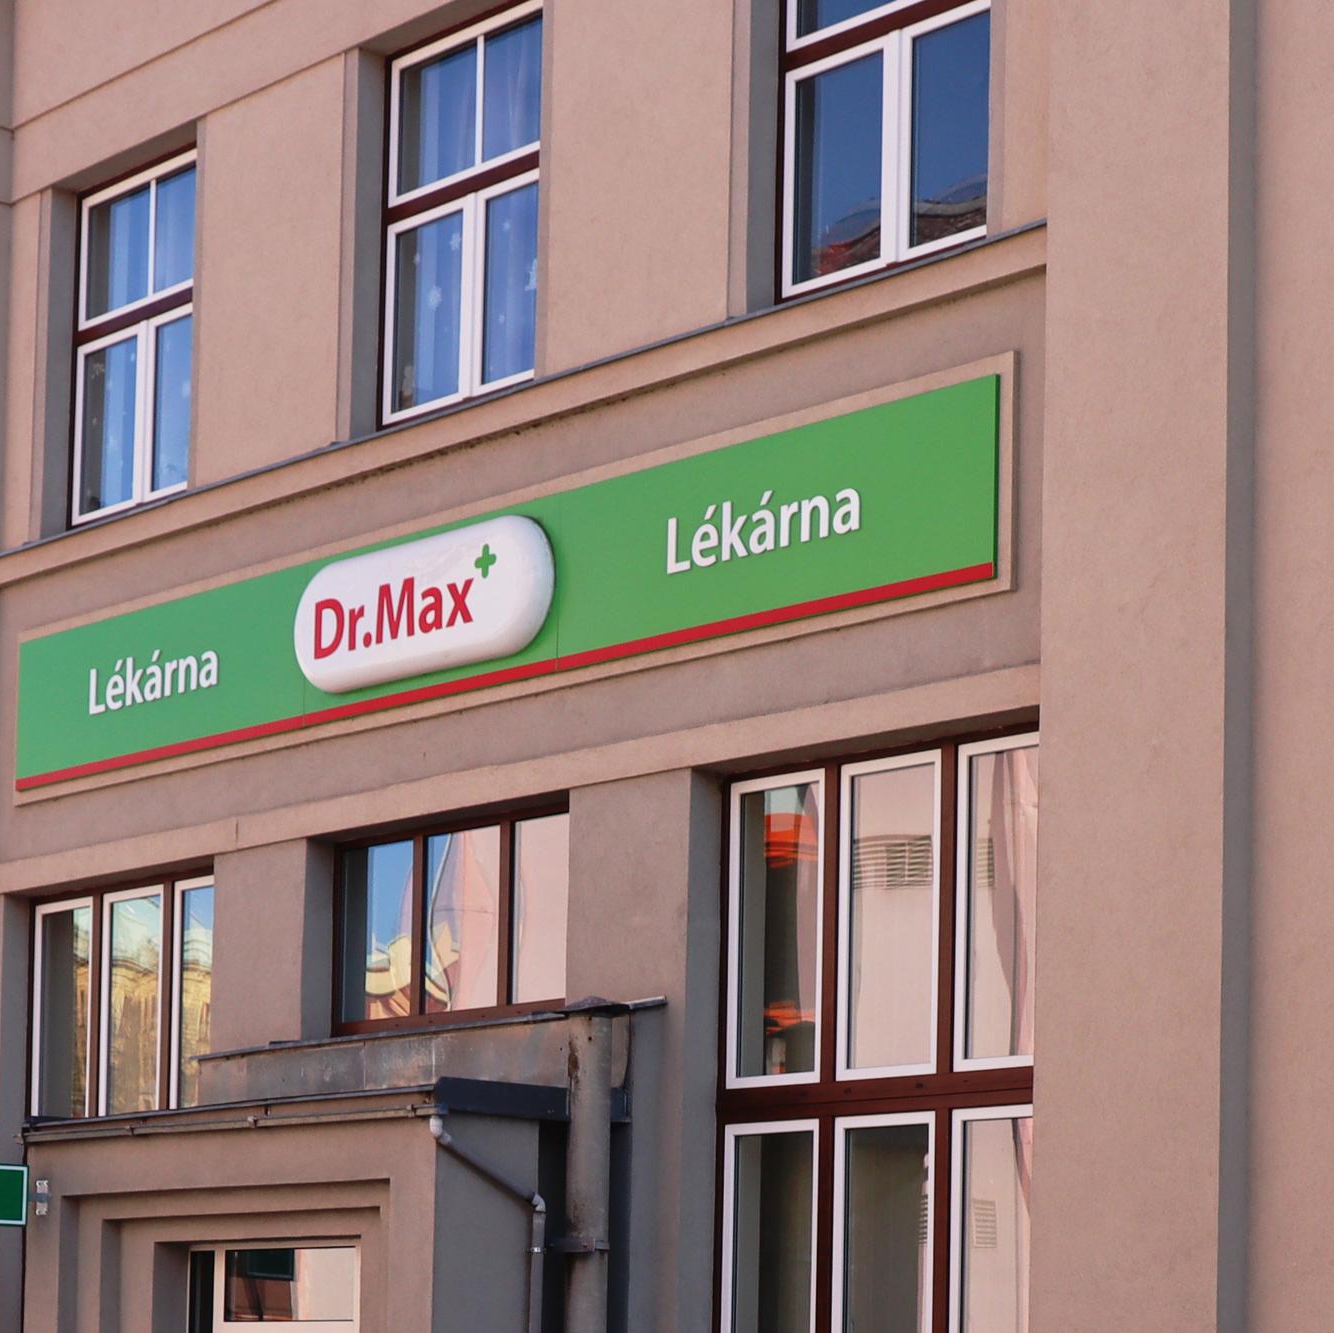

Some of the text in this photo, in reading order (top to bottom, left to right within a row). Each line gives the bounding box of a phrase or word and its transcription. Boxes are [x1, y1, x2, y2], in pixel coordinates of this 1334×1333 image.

[667, 487, 861, 574] Lékárna
[313, 576, 475, 659] Dr.Max
[88, 649, 218, 715] Lékárna
